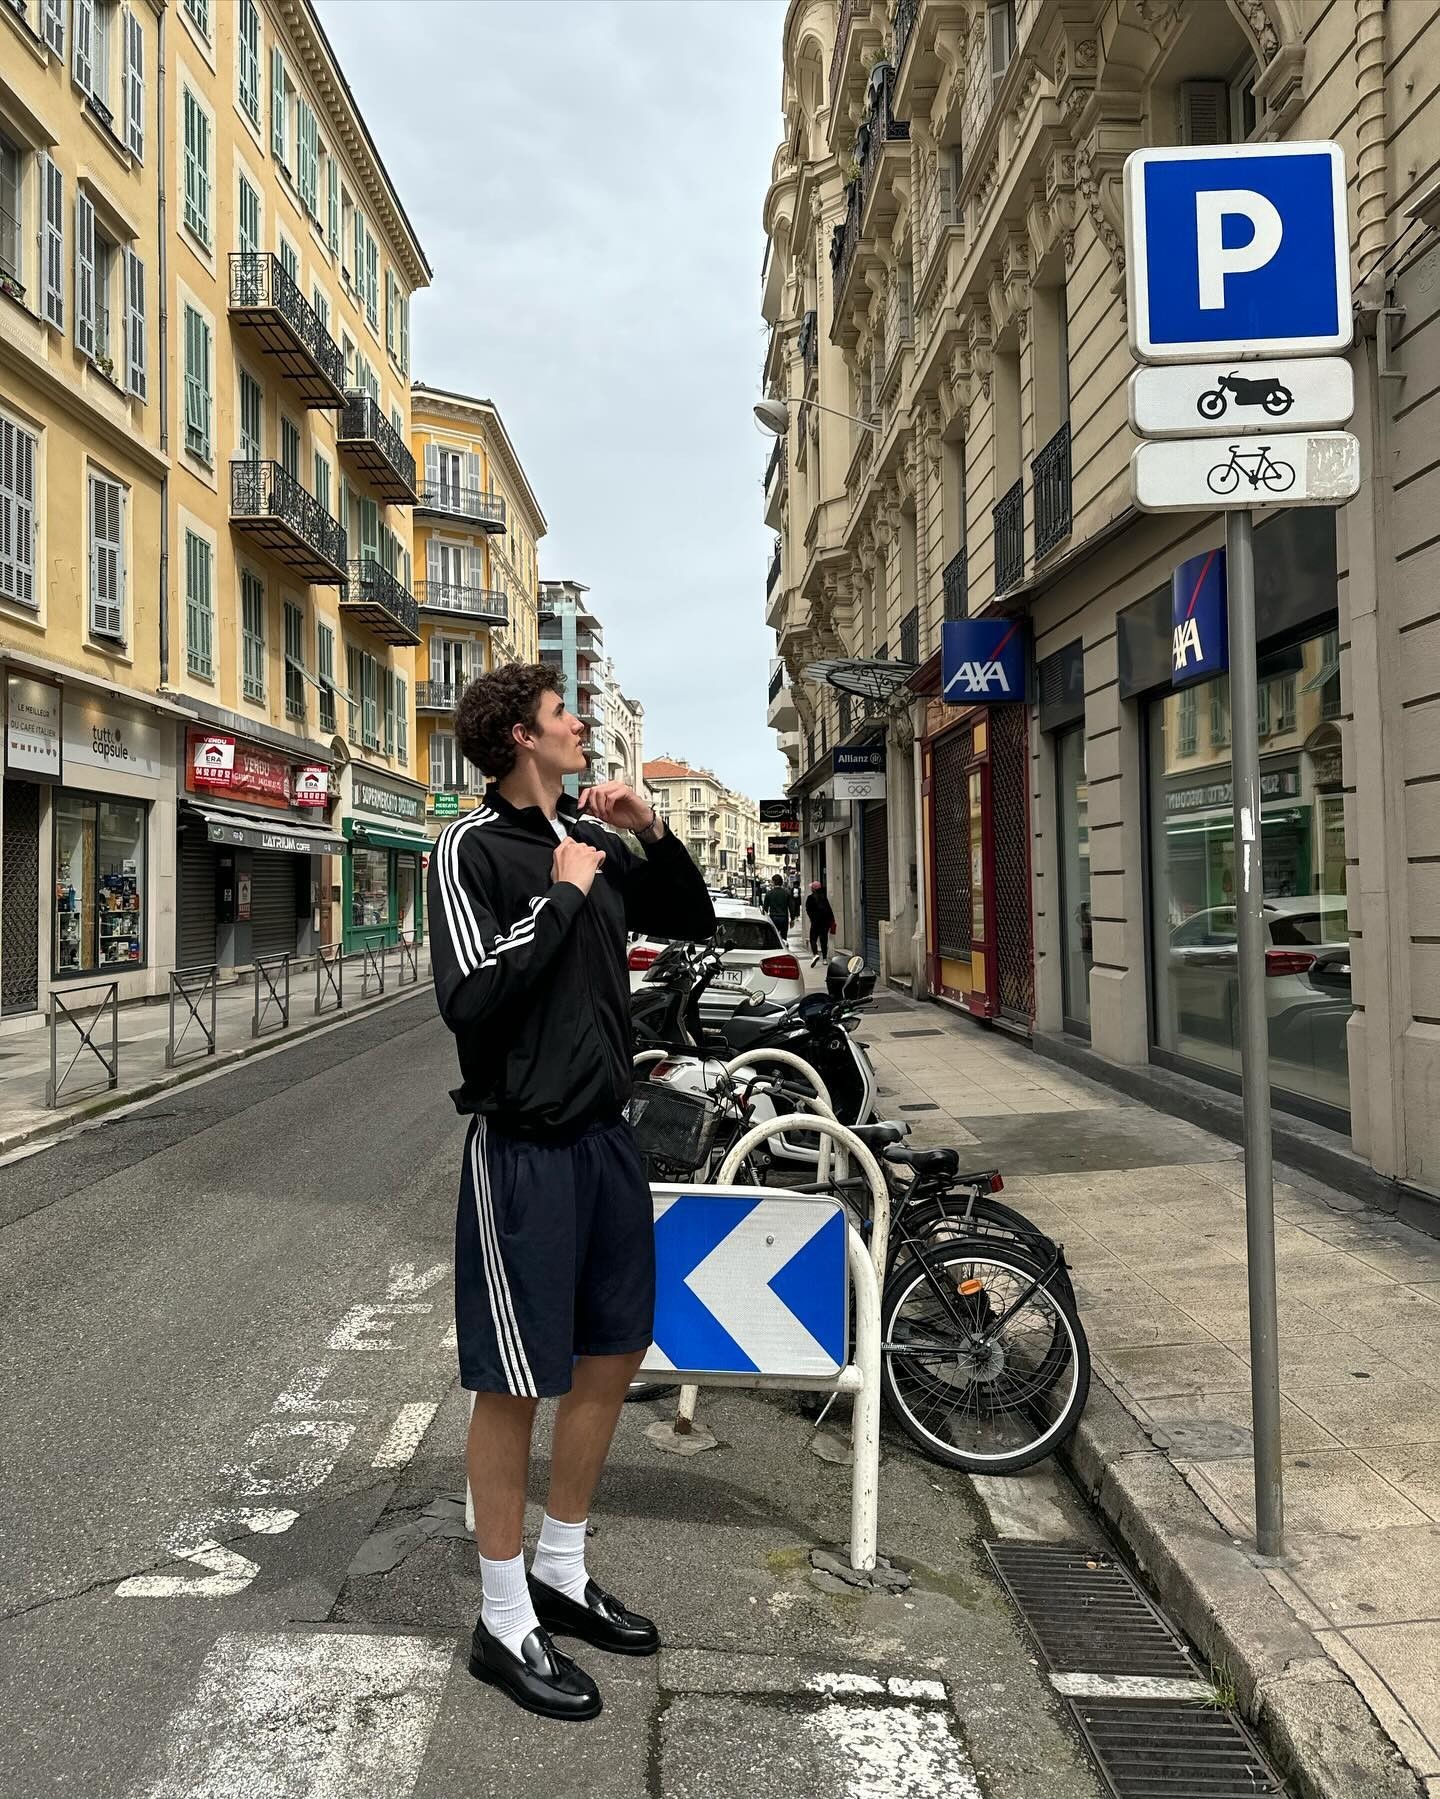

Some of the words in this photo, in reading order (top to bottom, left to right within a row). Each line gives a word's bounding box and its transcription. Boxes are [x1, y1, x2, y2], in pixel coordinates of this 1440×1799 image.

[1196, 189, 1283, 311] P
[1172, 617, 1204, 671] AXA
[943, 661, 1011, 694] AXA
[18, 704, 25, 712] LE
[25, 705, 50, 719] MEILLEUR
[92, 740, 128, 760] capsule
[838, 753, 869, 763] Allianz
[206, 755, 222, 763] ERA
[727, 971, 740, 981] TK
